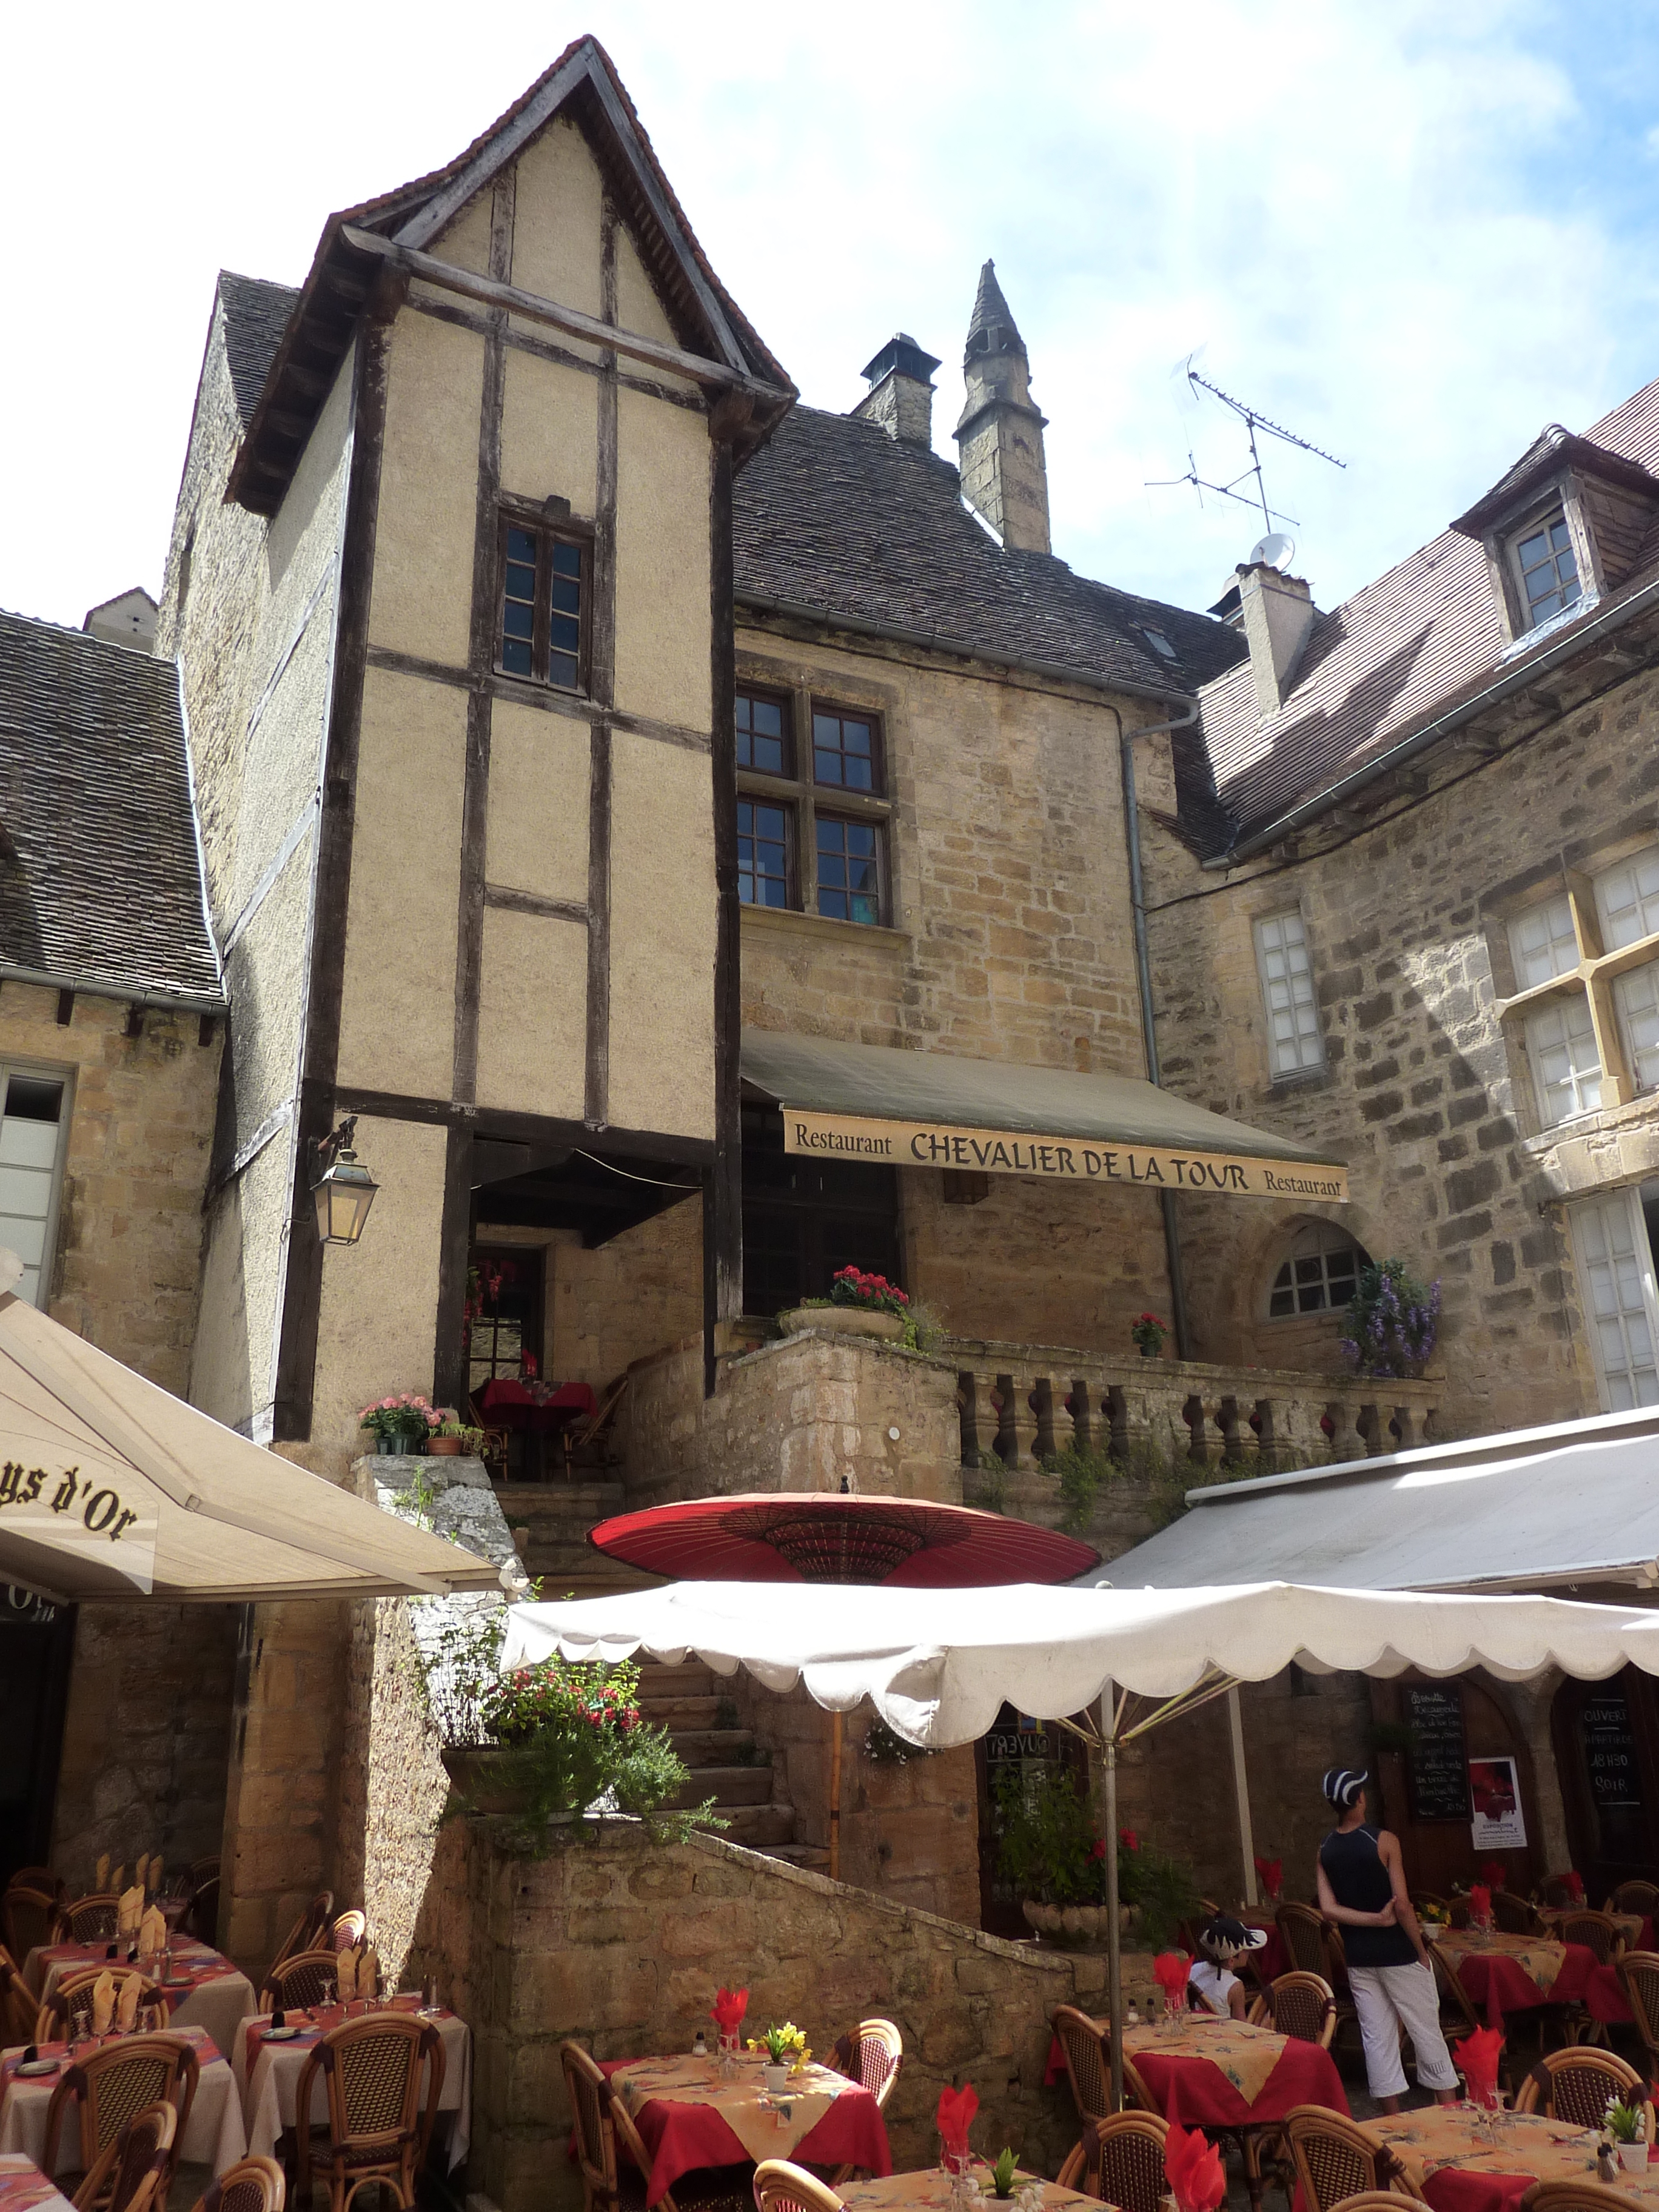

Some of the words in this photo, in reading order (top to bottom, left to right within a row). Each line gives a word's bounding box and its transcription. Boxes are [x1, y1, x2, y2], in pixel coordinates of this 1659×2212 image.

[794, 1124, 892, 1155] Restaurant
[911, 1133, 1077, 1174] CHEVALIER
[1082, 1150, 1121, 1178] DE
[1127, 1154, 1165, 1182] LA
[1170, 1159, 1250, 1190] TOUR
[1263, 1170, 1341, 1196] Restaurant
[51, 1466, 138, 1541] d'Or
[1584, 1709, 1627, 1722] OUVERT
[1595, 1775, 1628, 1792] SOIR
